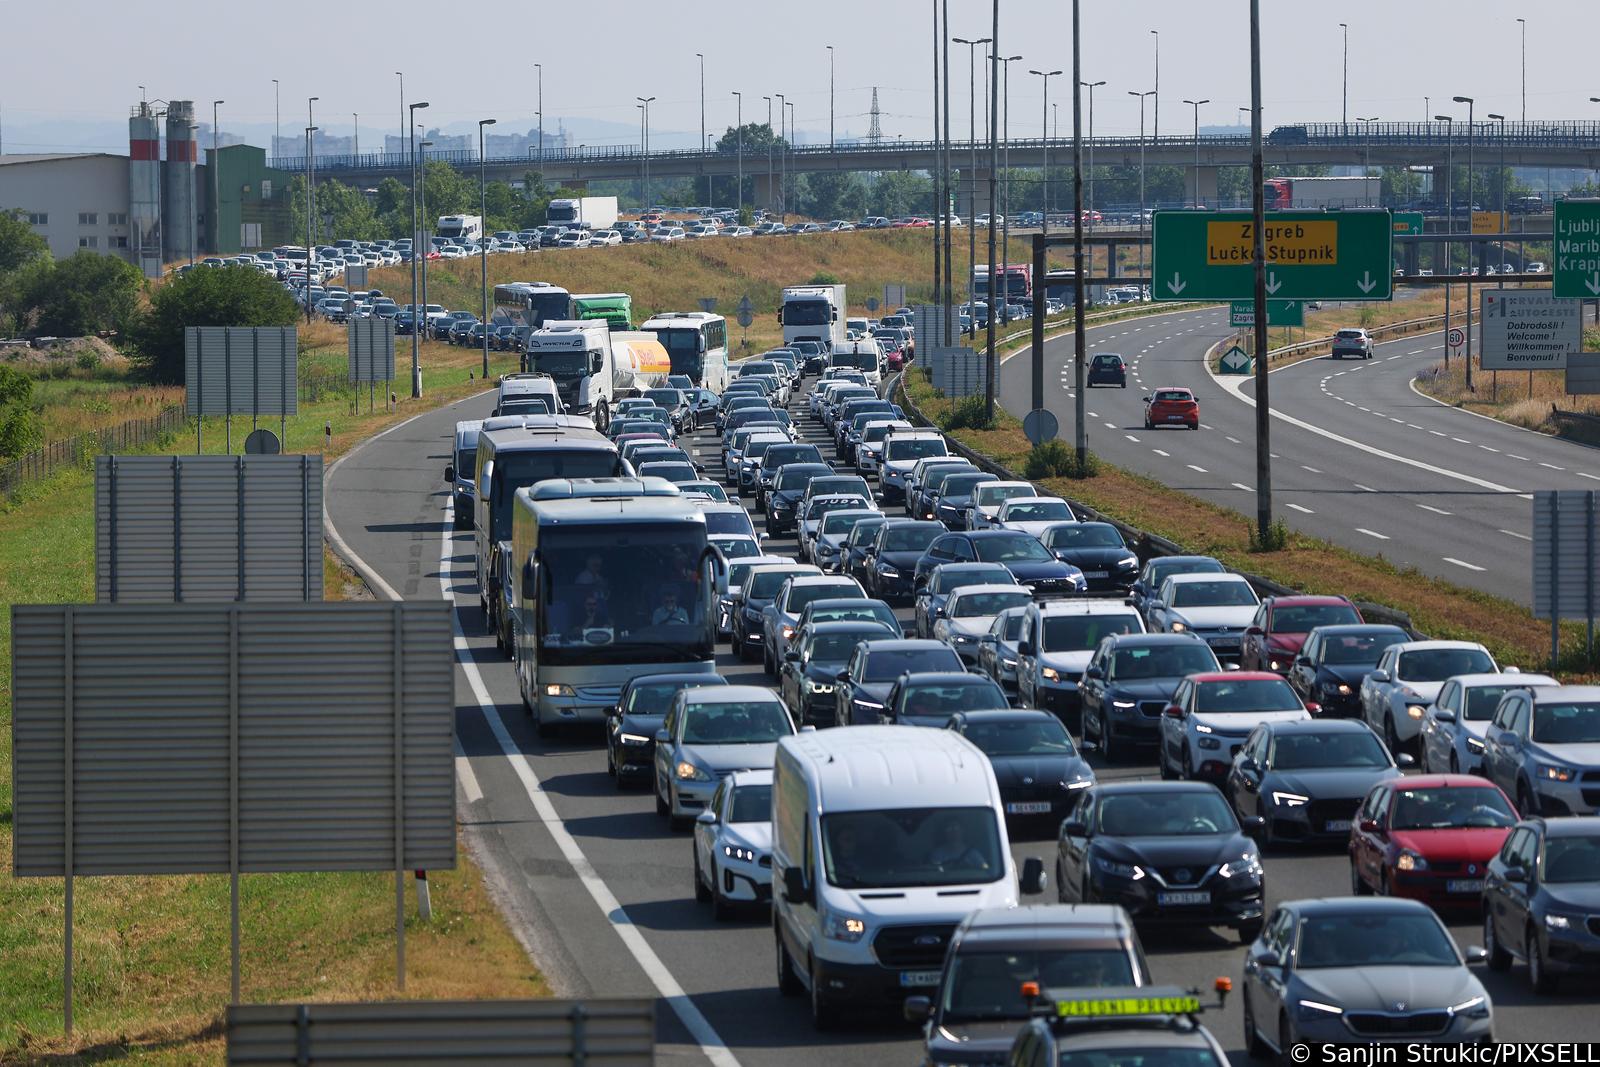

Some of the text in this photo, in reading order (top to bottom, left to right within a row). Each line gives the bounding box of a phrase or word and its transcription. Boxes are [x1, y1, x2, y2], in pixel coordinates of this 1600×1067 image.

[1241, 224, 1304, 241] Zgreb
[1268, 245, 1333, 263] Stupnik
[1509, 308, 1576, 317] AUTOCESTE
[1234, 314, 1255, 322] Zagre
[1506, 321, 1559, 330] Dobrodošli
[1449, 333, 1460, 343] 60
[1507, 332, 1550, 341] Welcome
[1507, 343, 1564, 351] Willkommen
[1506, 353, 1555, 362] Benvenuti
